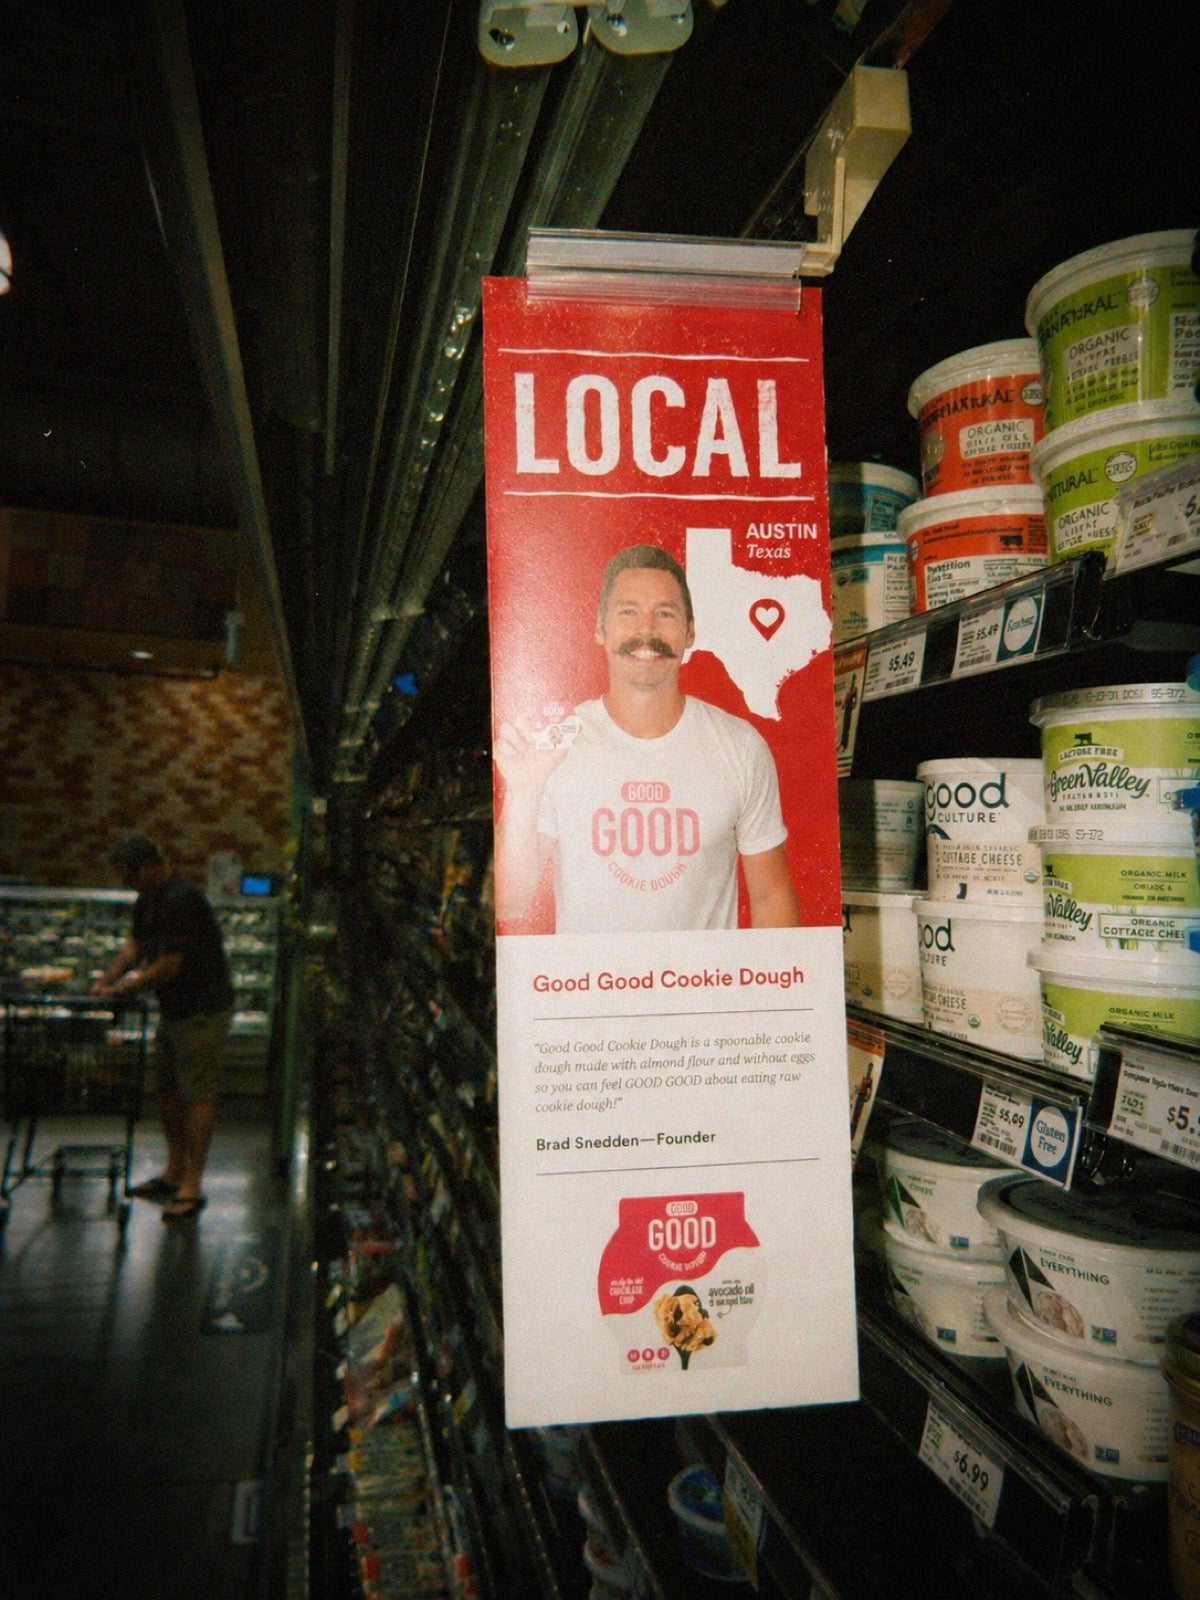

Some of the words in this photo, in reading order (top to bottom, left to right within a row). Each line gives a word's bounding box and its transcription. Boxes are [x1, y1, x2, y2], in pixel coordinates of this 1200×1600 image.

[1069, 327, 1131, 360] ORGANIC
[514, 371, 801, 478] LOCAL
[967, 420, 1024, 439] ORGANIC
[1058, 502, 1110, 530] ORGANIC
[746, 523, 818, 540] AUSTIN
[746, 544, 792, 560] Texas
[888, 651, 915, 672] $5.49
[627, 783, 664, 801] GOOD
[1079, 763, 1152, 799] Valley
[926, 772, 1010, 822] good
[937, 812, 999, 824] CULTURE
[591, 806, 701, 858] GOOD
[980, 852, 1024, 867] CHEESE
[607, 861, 647, 892] COOKIE
[650, 861, 687, 892] DOUGH
[1121, 869, 1162, 879] ORGANIC
[1165, 870, 1188, 879] MILK
[1049, 894, 1094, 932] Valley
[1131, 918, 1176, 928] ORGANIC
[1103, 926, 1155, 938] COTTAGE
[533, 973, 590, 993] Good
[597, 970, 655, 991] Good
[660, 968, 734, 988] Cookie
[739, 966, 805, 989] Dough
[1108, 1007, 1149, 1019] ORGANIC
[1152, 1011, 1175, 1021] MILK
[574, 1039, 604, 1053] Good
[607, 1038, 648, 1052] Cookie
[650, 1036, 687, 1052] Dough
[690, 1036, 701, 1049] is
[703, 1038, 711, 1048] a
[713, 1033, 772, 1050] spoonable
[774, 1031, 812, 1046] cookie
[535, 1061, 574, 1075] dough
[574, 1059, 608, 1073] made
[611, 1058, 637, 1072] with
[640, 1055, 685, 1070] almond
[686, 1053, 716, 1071] flour
[718, 1053, 740, 1067] and
[743, 1051, 788, 1066] without
[790, 1052, 816, 1065] eggs
[535, 1084, 548, 1094] so
[551, 1083, 573, 1097] you
[576, 1081, 598, 1092] can
[600, 1078, 623, 1094] feel
[625, 1076, 663, 1090] GOOD
[665, 1074, 703, 1088] GOOD
[705, 1071, 738, 1086] about
[741, 1071, 777, 1086] eating
[779, 1071, 802, 1083] raw
[535, 1099, 574, 1114] cookie
[1036, 1119, 1066, 1143] Gluten
[536, 1137, 570, 1152] Brad
[1037, 1135, 1058, 1155] Free
[670, 1203, 695, 1215] GOOD
[648, 1216, 717, 1251] GOOD
[1040, 1257, 1110, 1286] EVERYTHING
[708, 1284, 743, 1297] avocado
[1044, 1374, 1114, 1408] EVERYTHING
[953, 1449, 990, 1491] $6.99
